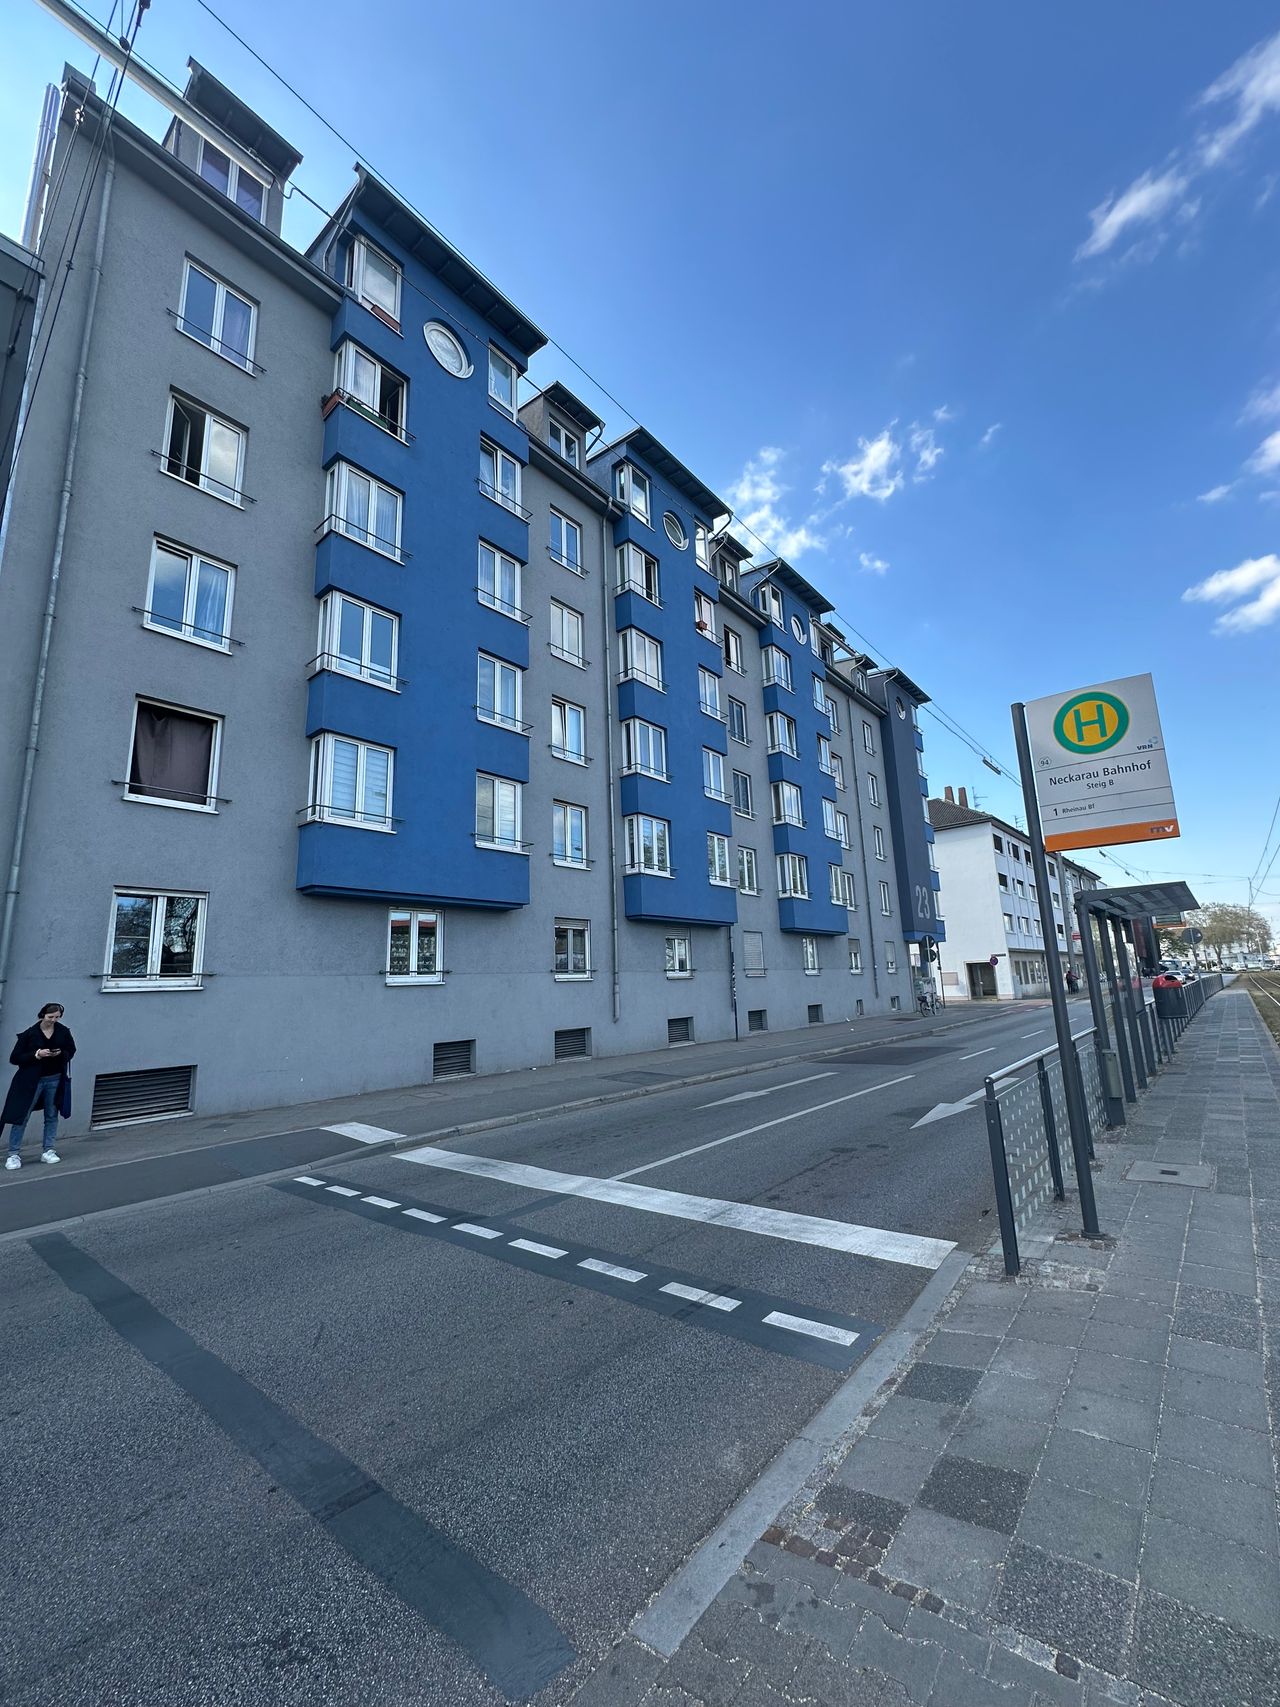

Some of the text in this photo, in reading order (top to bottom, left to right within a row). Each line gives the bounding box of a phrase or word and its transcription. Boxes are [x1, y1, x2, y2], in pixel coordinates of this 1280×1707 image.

[1073, 704, 1107, 742] H
[1040, 759, 1049, 767] 94
[1049, 760, 1151, 786] Neckarau Bahnhof
[1086, 780, 1106, 790] Steig
[1053, 808, 1058, 816] 1
[1062, 805, 1087, 814] Rheinau
[915, 885, 930, 919] 23
